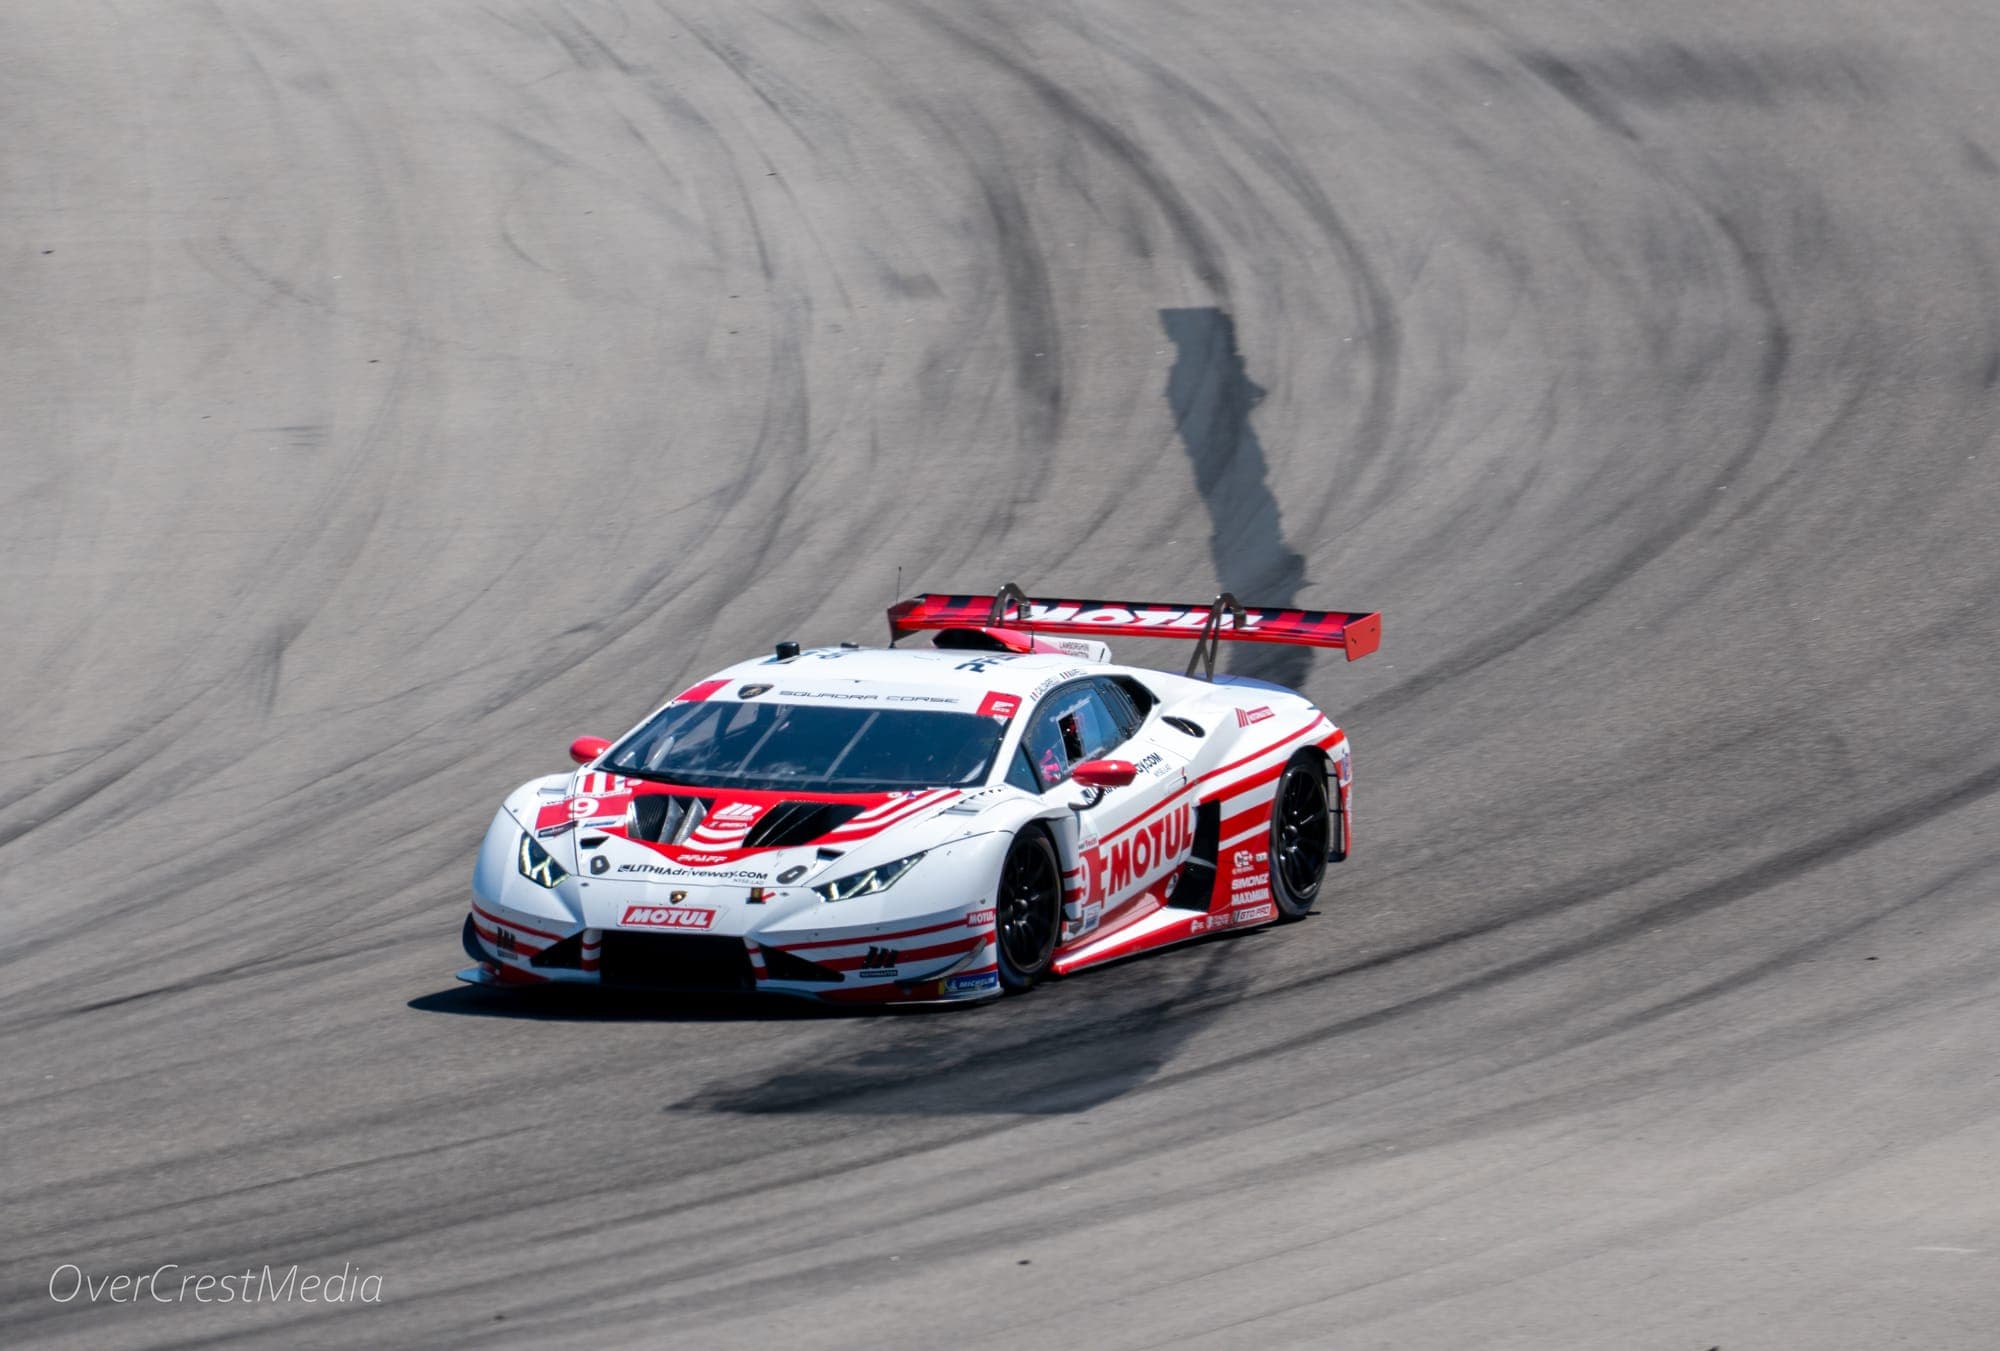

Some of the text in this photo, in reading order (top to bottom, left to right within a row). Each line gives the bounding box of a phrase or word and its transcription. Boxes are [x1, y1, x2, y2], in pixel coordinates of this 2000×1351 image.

[778, 689, 960, 704] SQUADRA CORSE
[567, 797, 600, 819] 9
[1108, 802, 1193, 897] MOTUL
[626, 909, 709, 926] MOTUL
